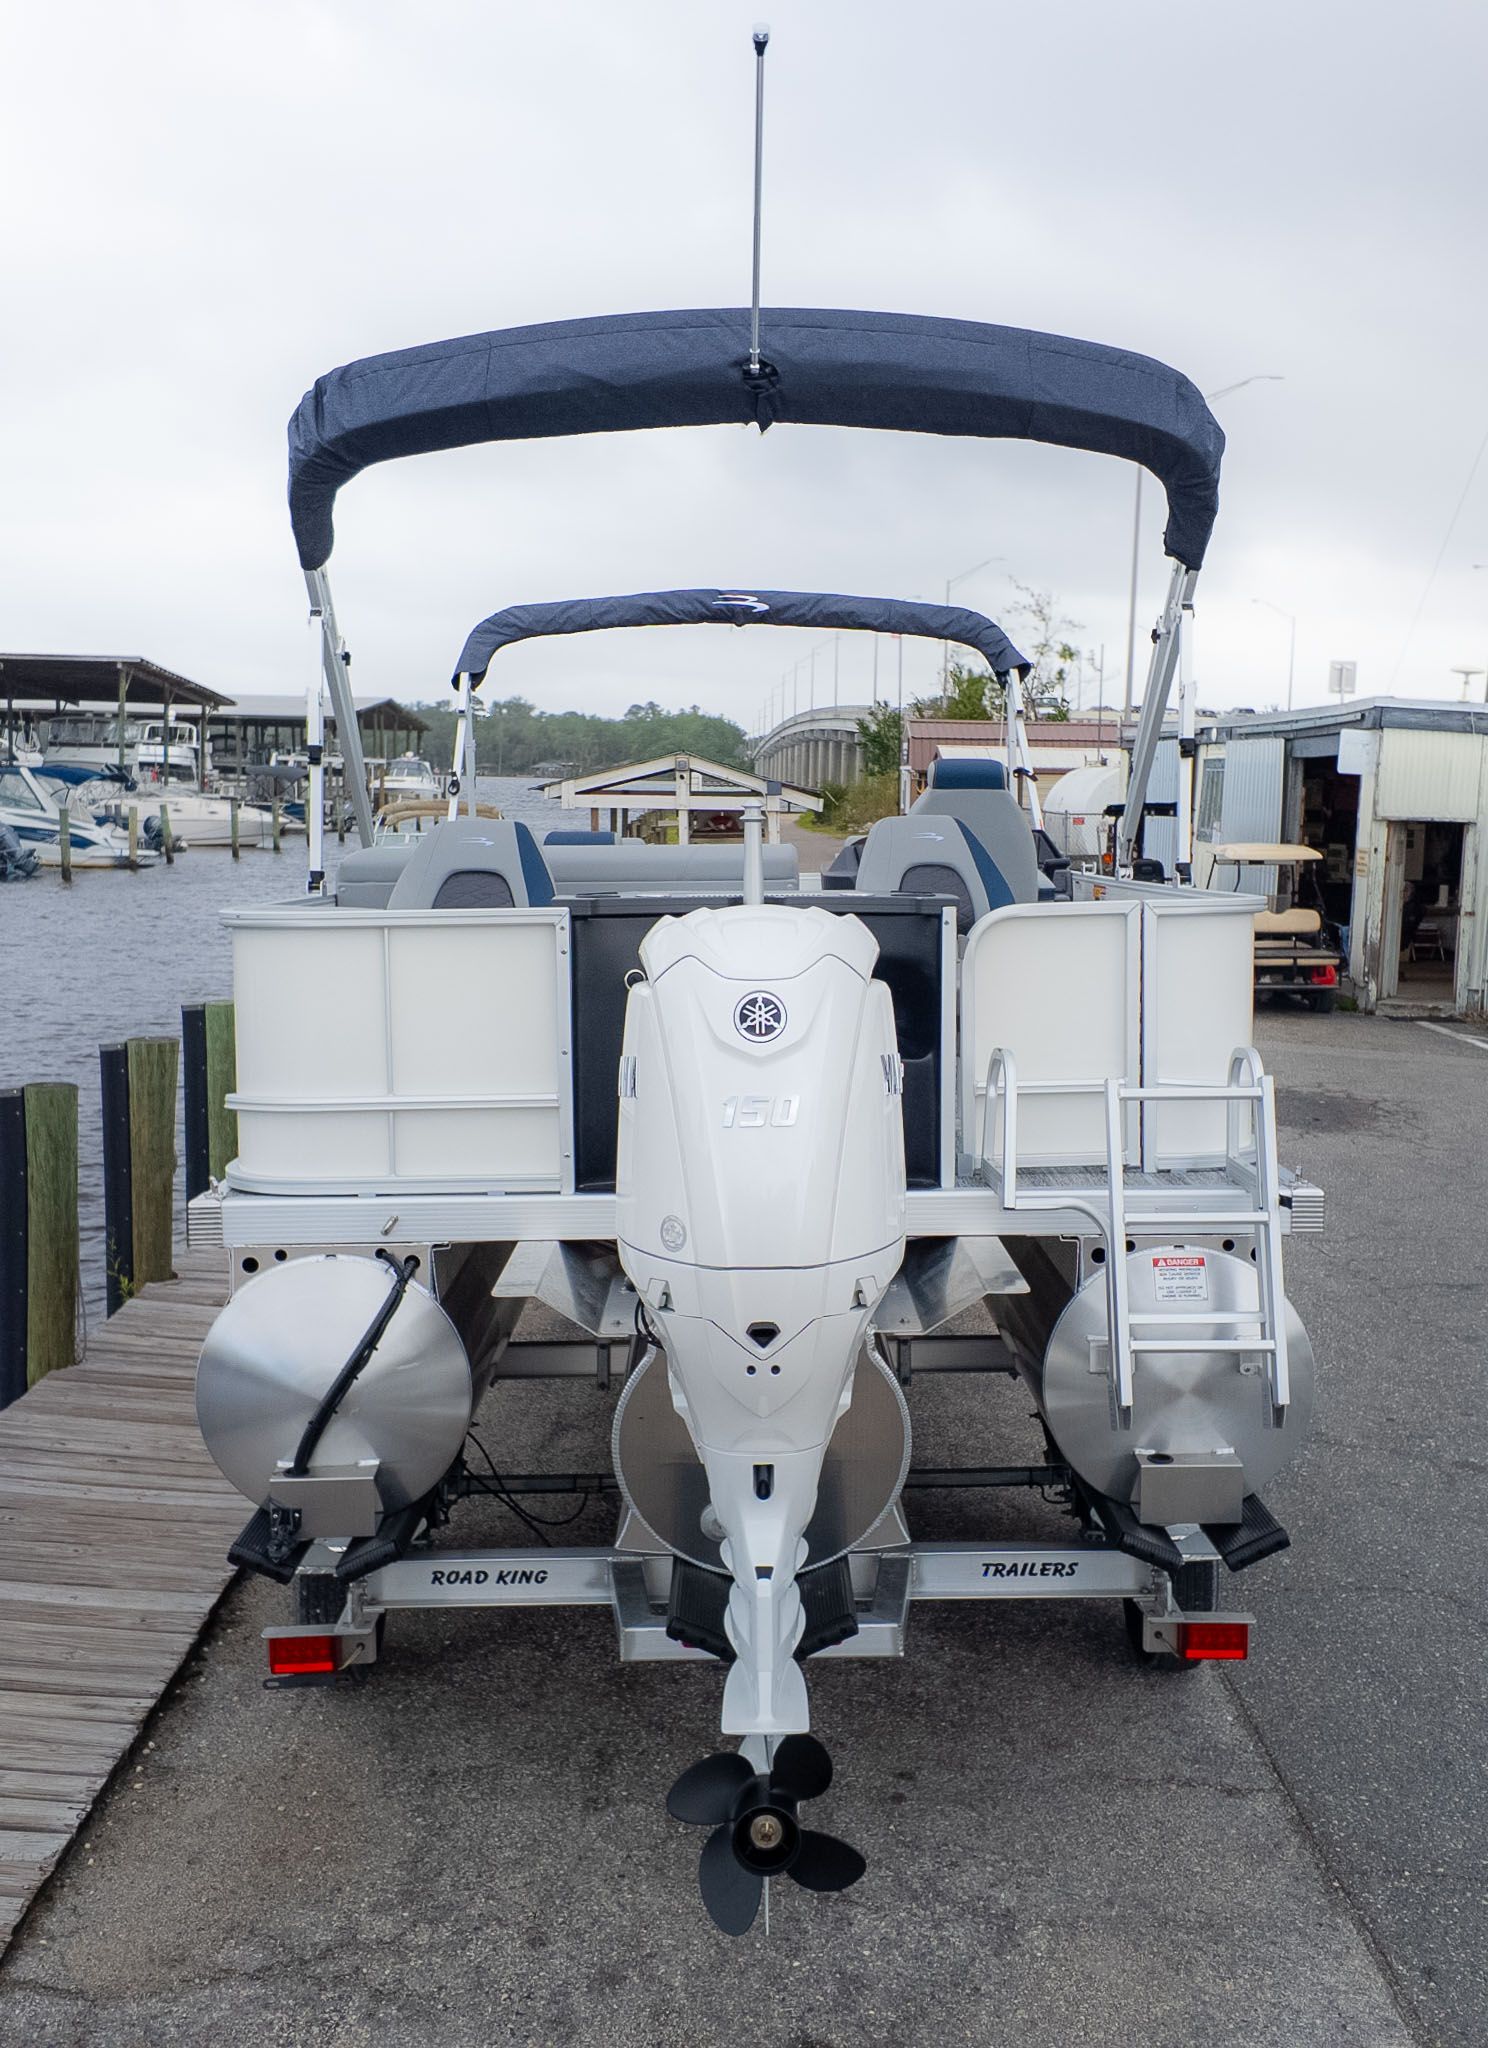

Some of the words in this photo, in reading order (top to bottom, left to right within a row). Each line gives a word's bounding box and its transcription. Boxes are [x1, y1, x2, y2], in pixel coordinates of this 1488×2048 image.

[720, 1095, 800, 1128] 150
[1166, 1258, 1199, 1266] DANGER
[431, 1570, 489, 1586] ROAD
[496, 1569, 549, 1586] KING
[981, 1562, 1079, 1578] TRAILERS
